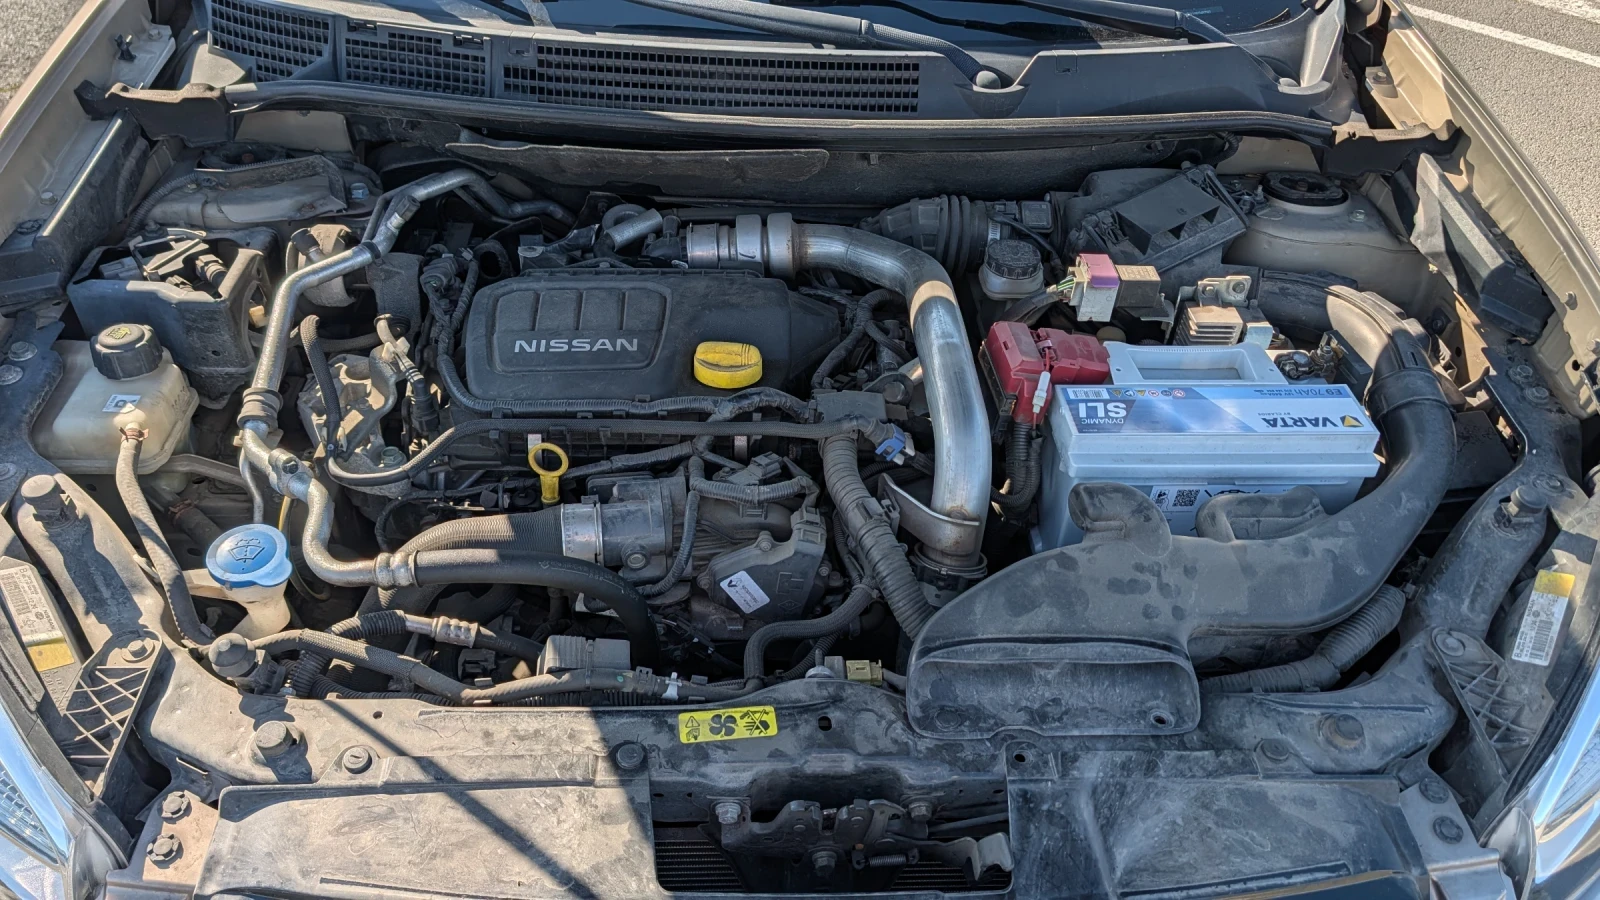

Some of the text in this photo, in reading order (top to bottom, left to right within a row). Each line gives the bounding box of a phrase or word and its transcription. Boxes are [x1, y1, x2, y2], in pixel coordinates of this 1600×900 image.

[514, 338, 638, 353] NISSAN
[1294, 388, 1325, 396] 70Ah
[1078, 402, 1127, 418] SLI
[1261, 417, 1339, 428] VARTA
[1526, 599, 1535, 617] NISSAN
[44, 609, 55, 629] NISSAN
